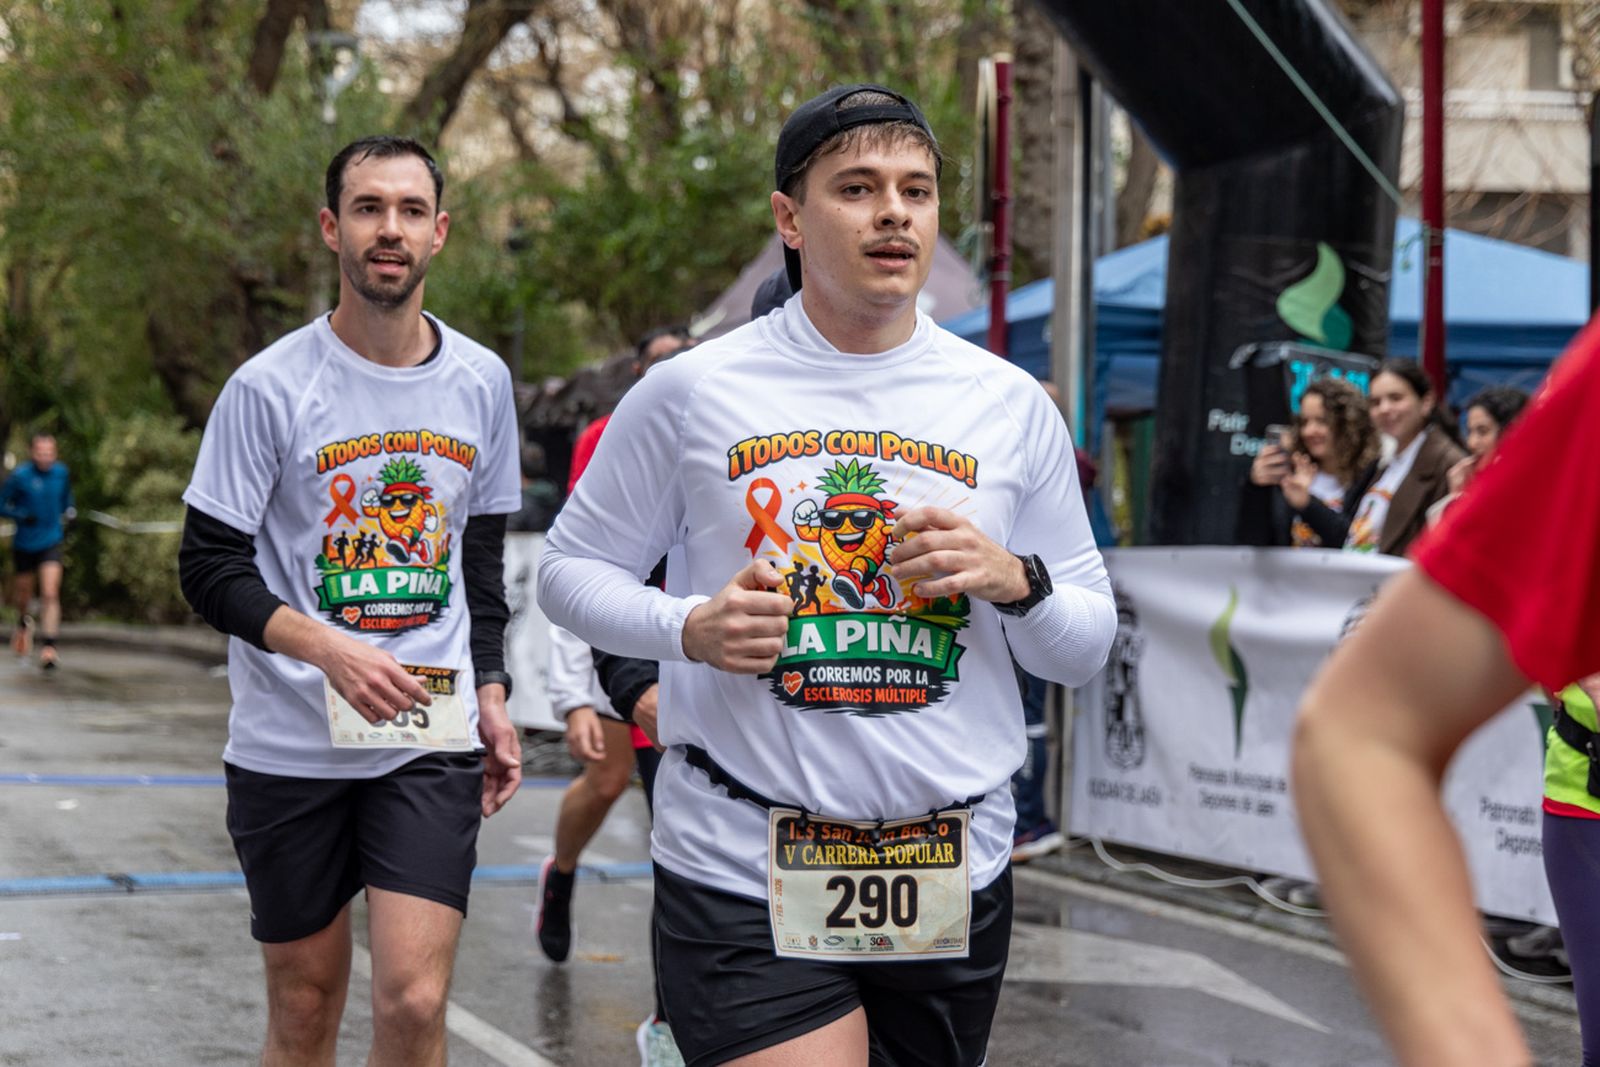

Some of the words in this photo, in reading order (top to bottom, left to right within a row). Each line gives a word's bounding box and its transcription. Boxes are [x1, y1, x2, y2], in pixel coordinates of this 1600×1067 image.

[316, 434, 381, 474] ¡TODOS
[383, 430, 419, 453] CON
[419, 429, 477, 471] POLLO!
[728, 430, 822, 481] ¡TODOS
[824, 430, 878, 457] CON
[879, 431, 978, 489] POLLO!
[341, 570, 379, 598] LA
[387, 568, 442, 596] PIÑA
[364, 602, 414, 617] CORREMOS
[781, 622, 827, 659] LA
[836, 614, 933, 659] PIÑA
[809, 666, 881, 684] CORREMOS
[886, 668, 911, 684] POR
[916, 670, 928, 685] LA
[804, 687, 872, 702] ESCLEROSIS
[875, 684, 927, 703] MÚLTIPLE
[822, 824, 853, 842] San
[857, 830, 895, 845] Jun
[900, 823, 949, 840] Boso
[784, 845, 795, 865] V
[802, 844, 880, 865] CARRERA
[884, 843, 955, 865] POPULAR
[826, 874, 919, 928] 290
